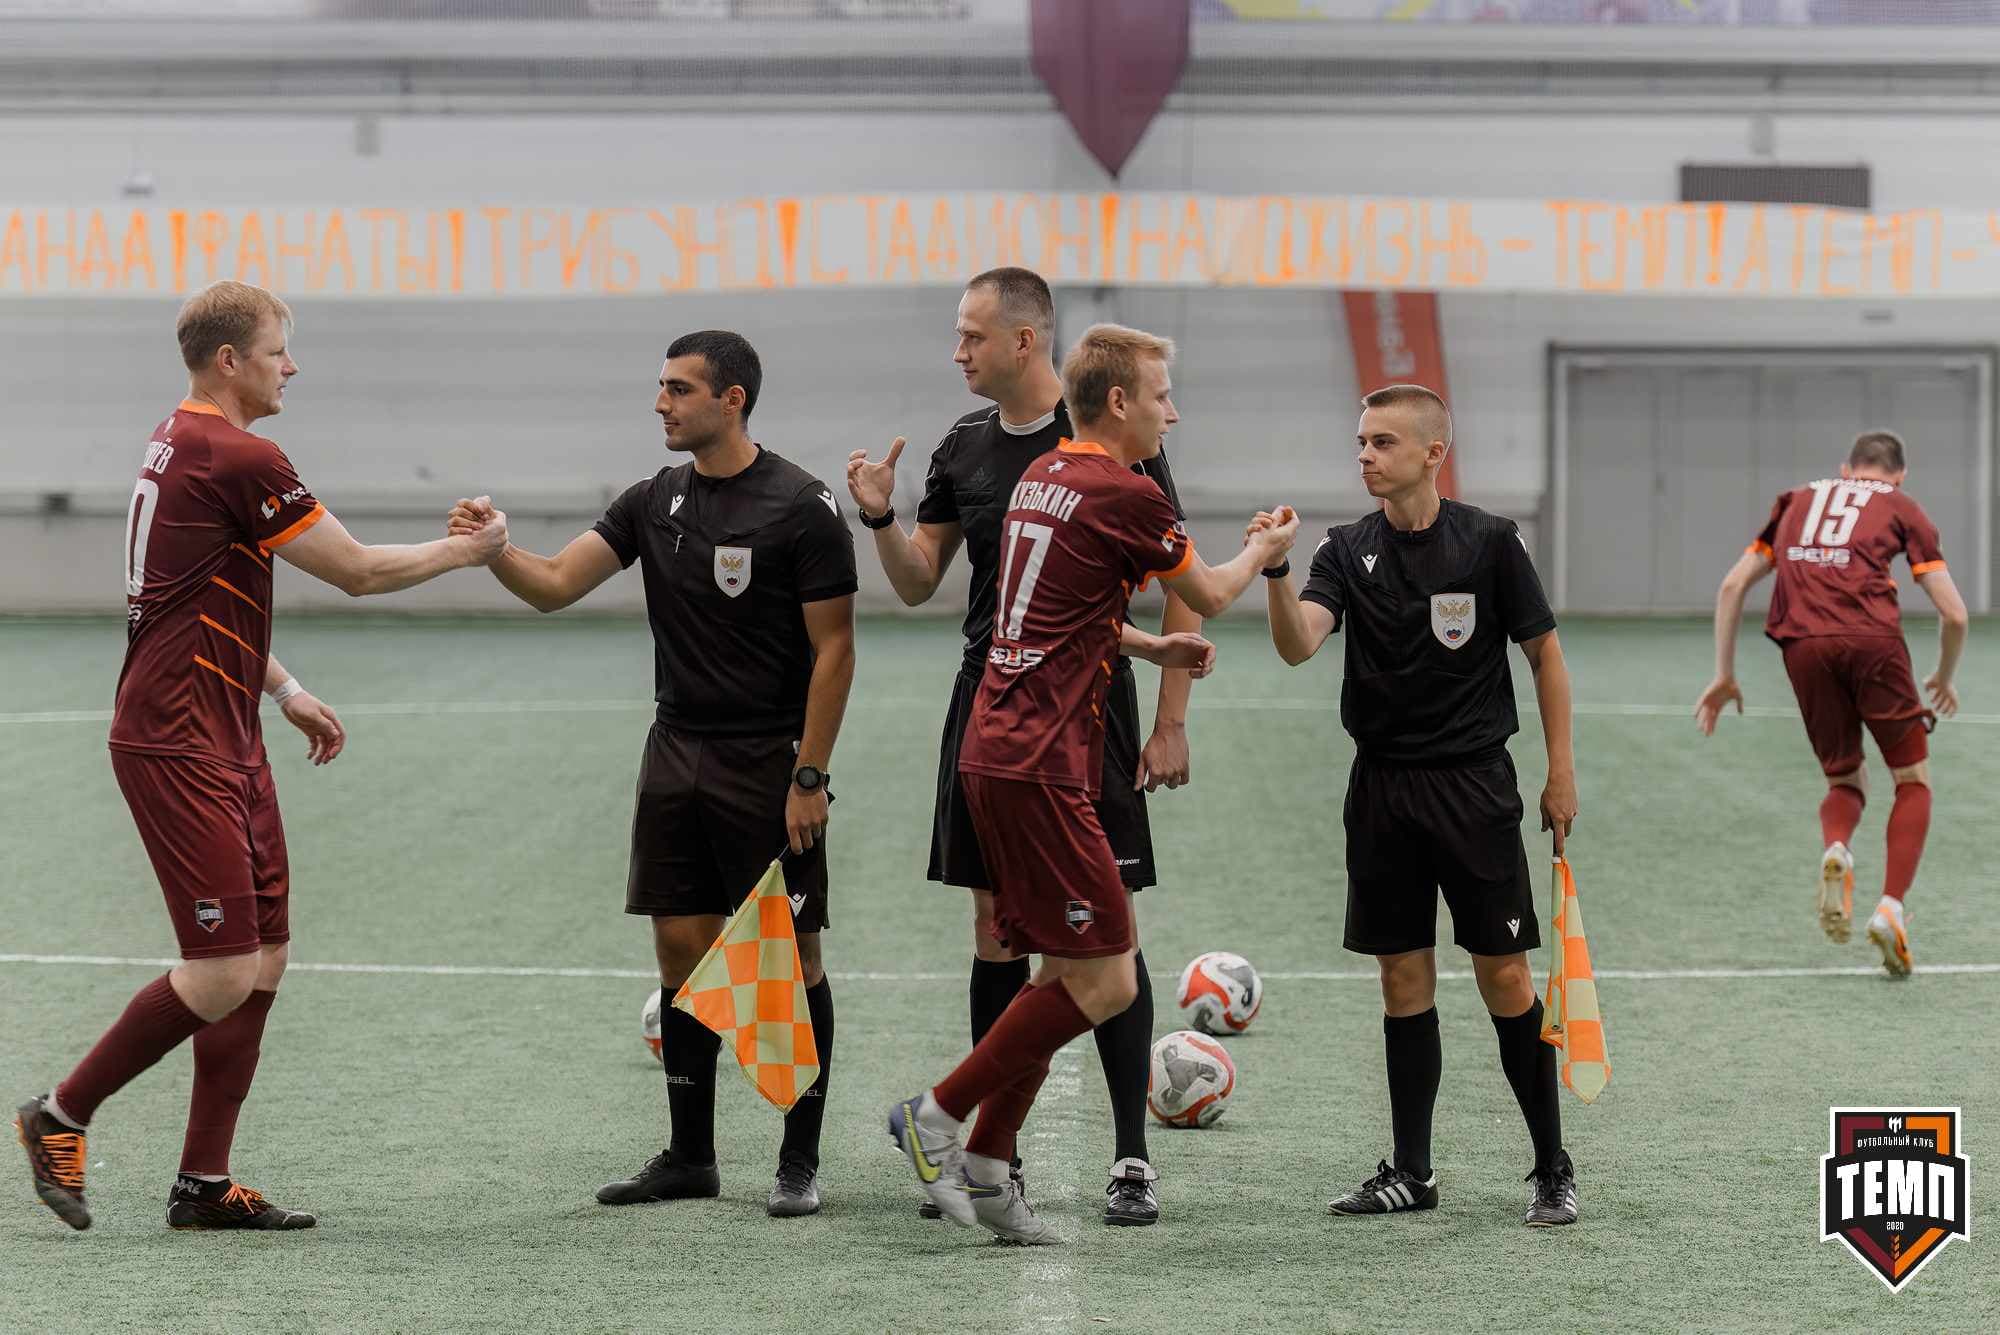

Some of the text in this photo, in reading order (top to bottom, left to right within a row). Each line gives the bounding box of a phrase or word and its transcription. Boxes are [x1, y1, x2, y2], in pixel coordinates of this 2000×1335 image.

[1542, 202, 1728, 290] ТЕМП!
[1008, 481, 1083, 522] КУЗЬКИН
[998, 521, 1054, 641] 17
